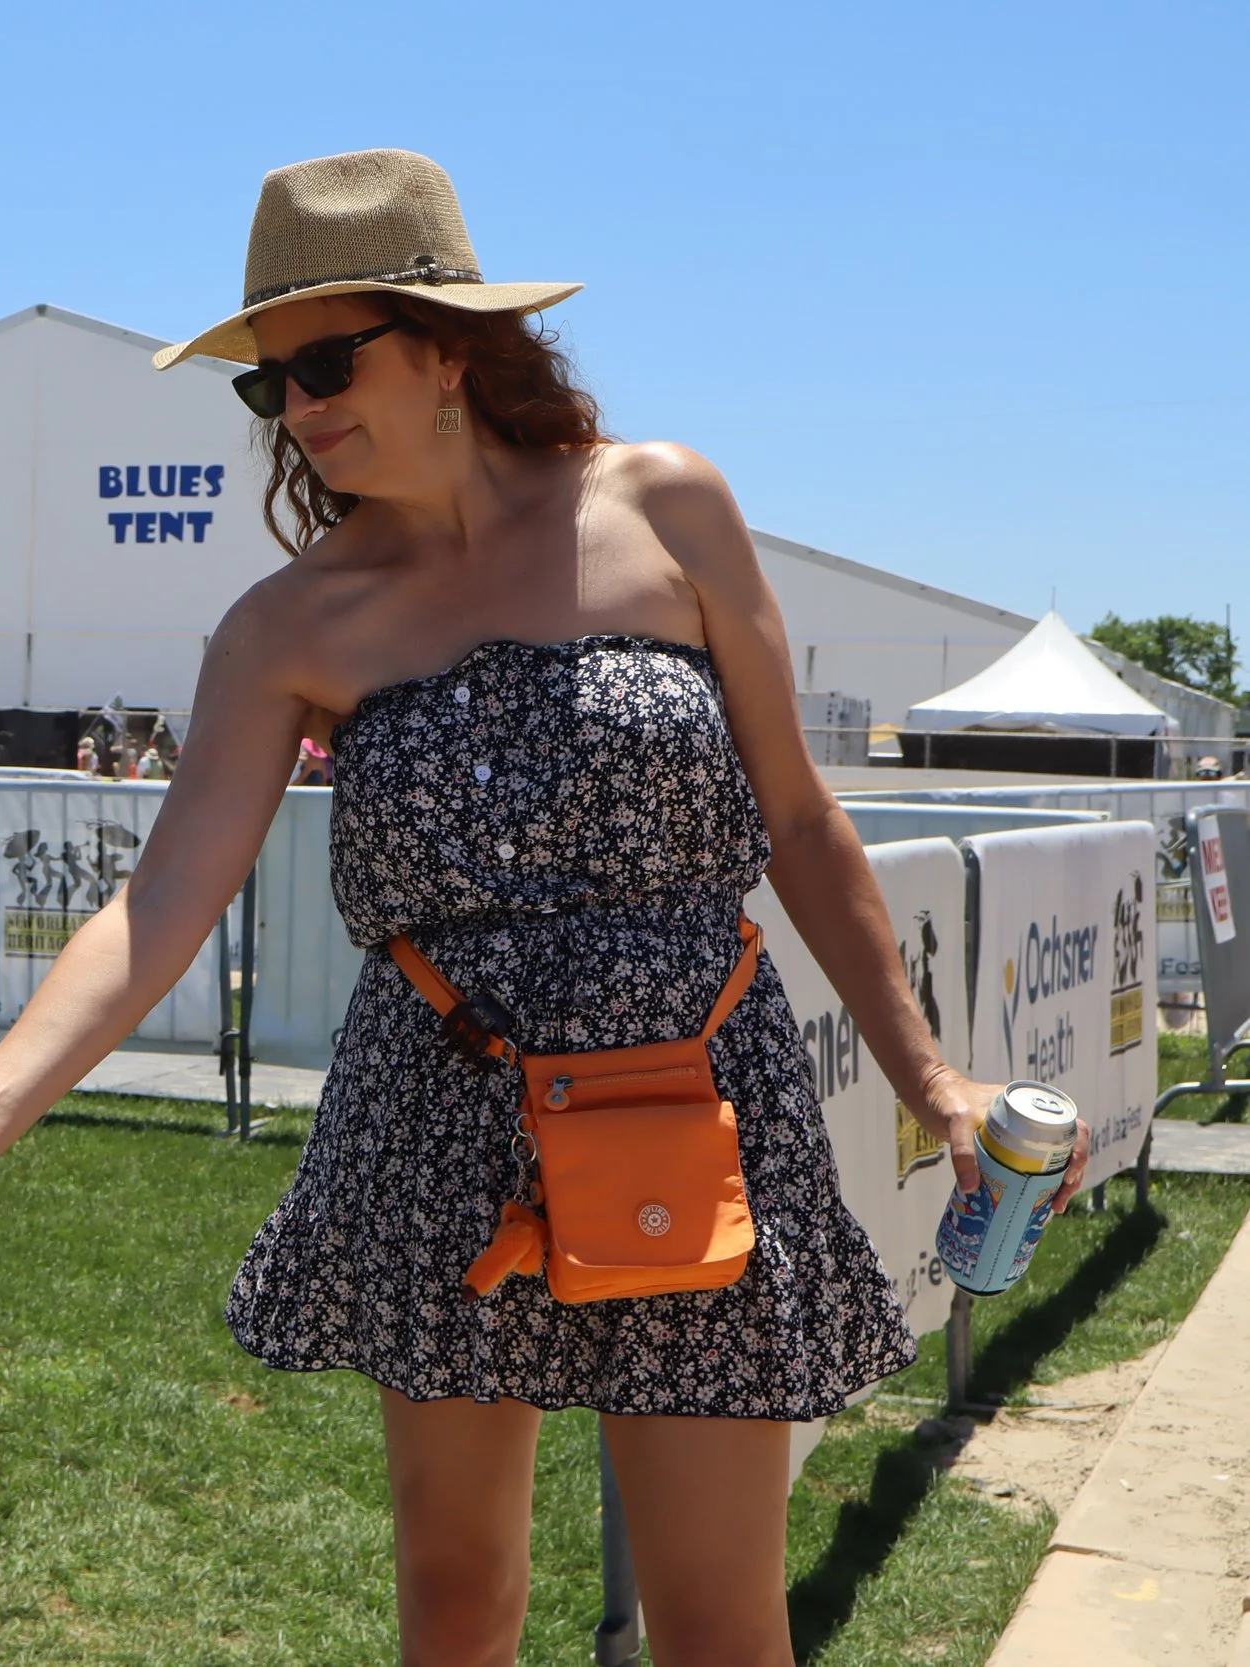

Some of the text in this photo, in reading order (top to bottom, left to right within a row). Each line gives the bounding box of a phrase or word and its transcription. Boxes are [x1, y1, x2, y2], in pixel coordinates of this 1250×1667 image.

[99, 465, 225, 499] BLUES
[108, 511, 213, 544] TENT
[1026, 914, 1098, 1004] Ochsner
[802, 1003, 860, 1104] sner
[1027, 1011, 1074, 1083] Health
